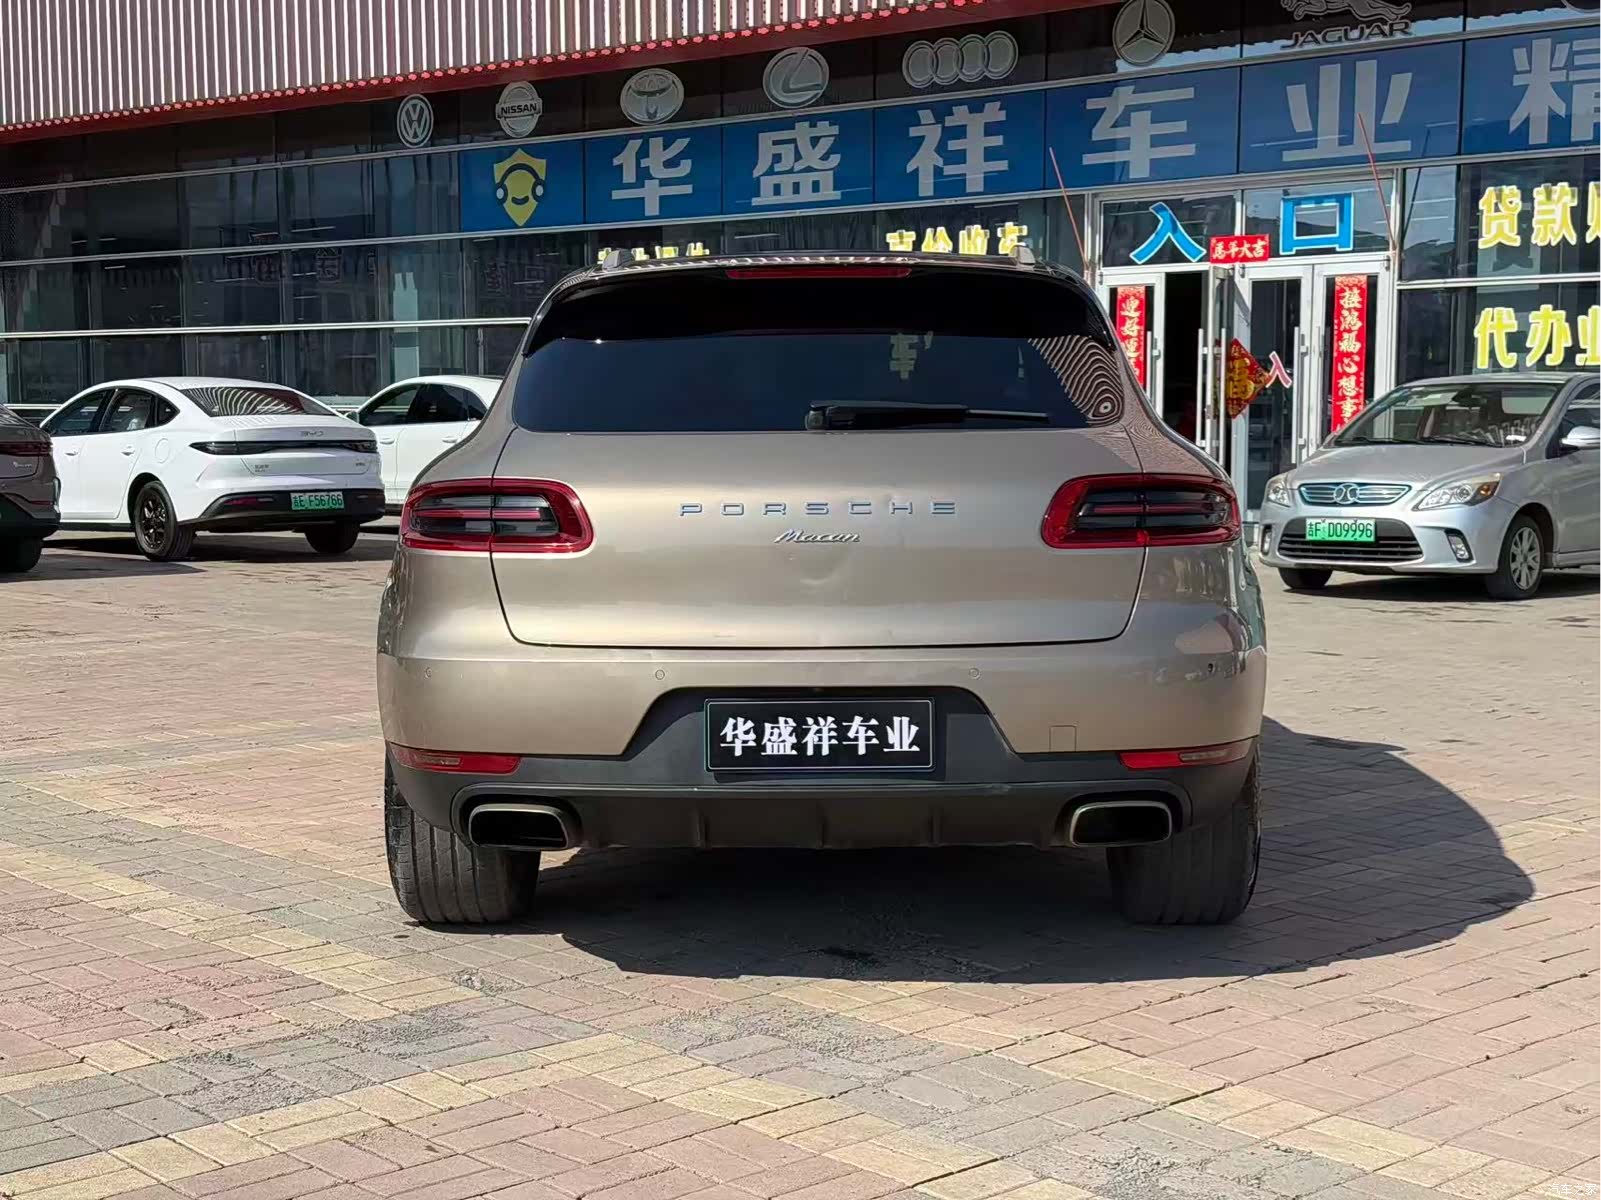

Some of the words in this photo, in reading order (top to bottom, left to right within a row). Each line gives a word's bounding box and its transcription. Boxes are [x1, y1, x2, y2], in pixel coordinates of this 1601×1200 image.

[1281, 20, 1411, 49] JAGUAR
[500, 102, 538, 115] NISSAN
[1129, 191, 1354, 266] 入口
[680, 501, 956, 516] PORSCHE
[773, 528, 861, 544] Macan
[719, 715, 921, 757] 华盛祥车业
